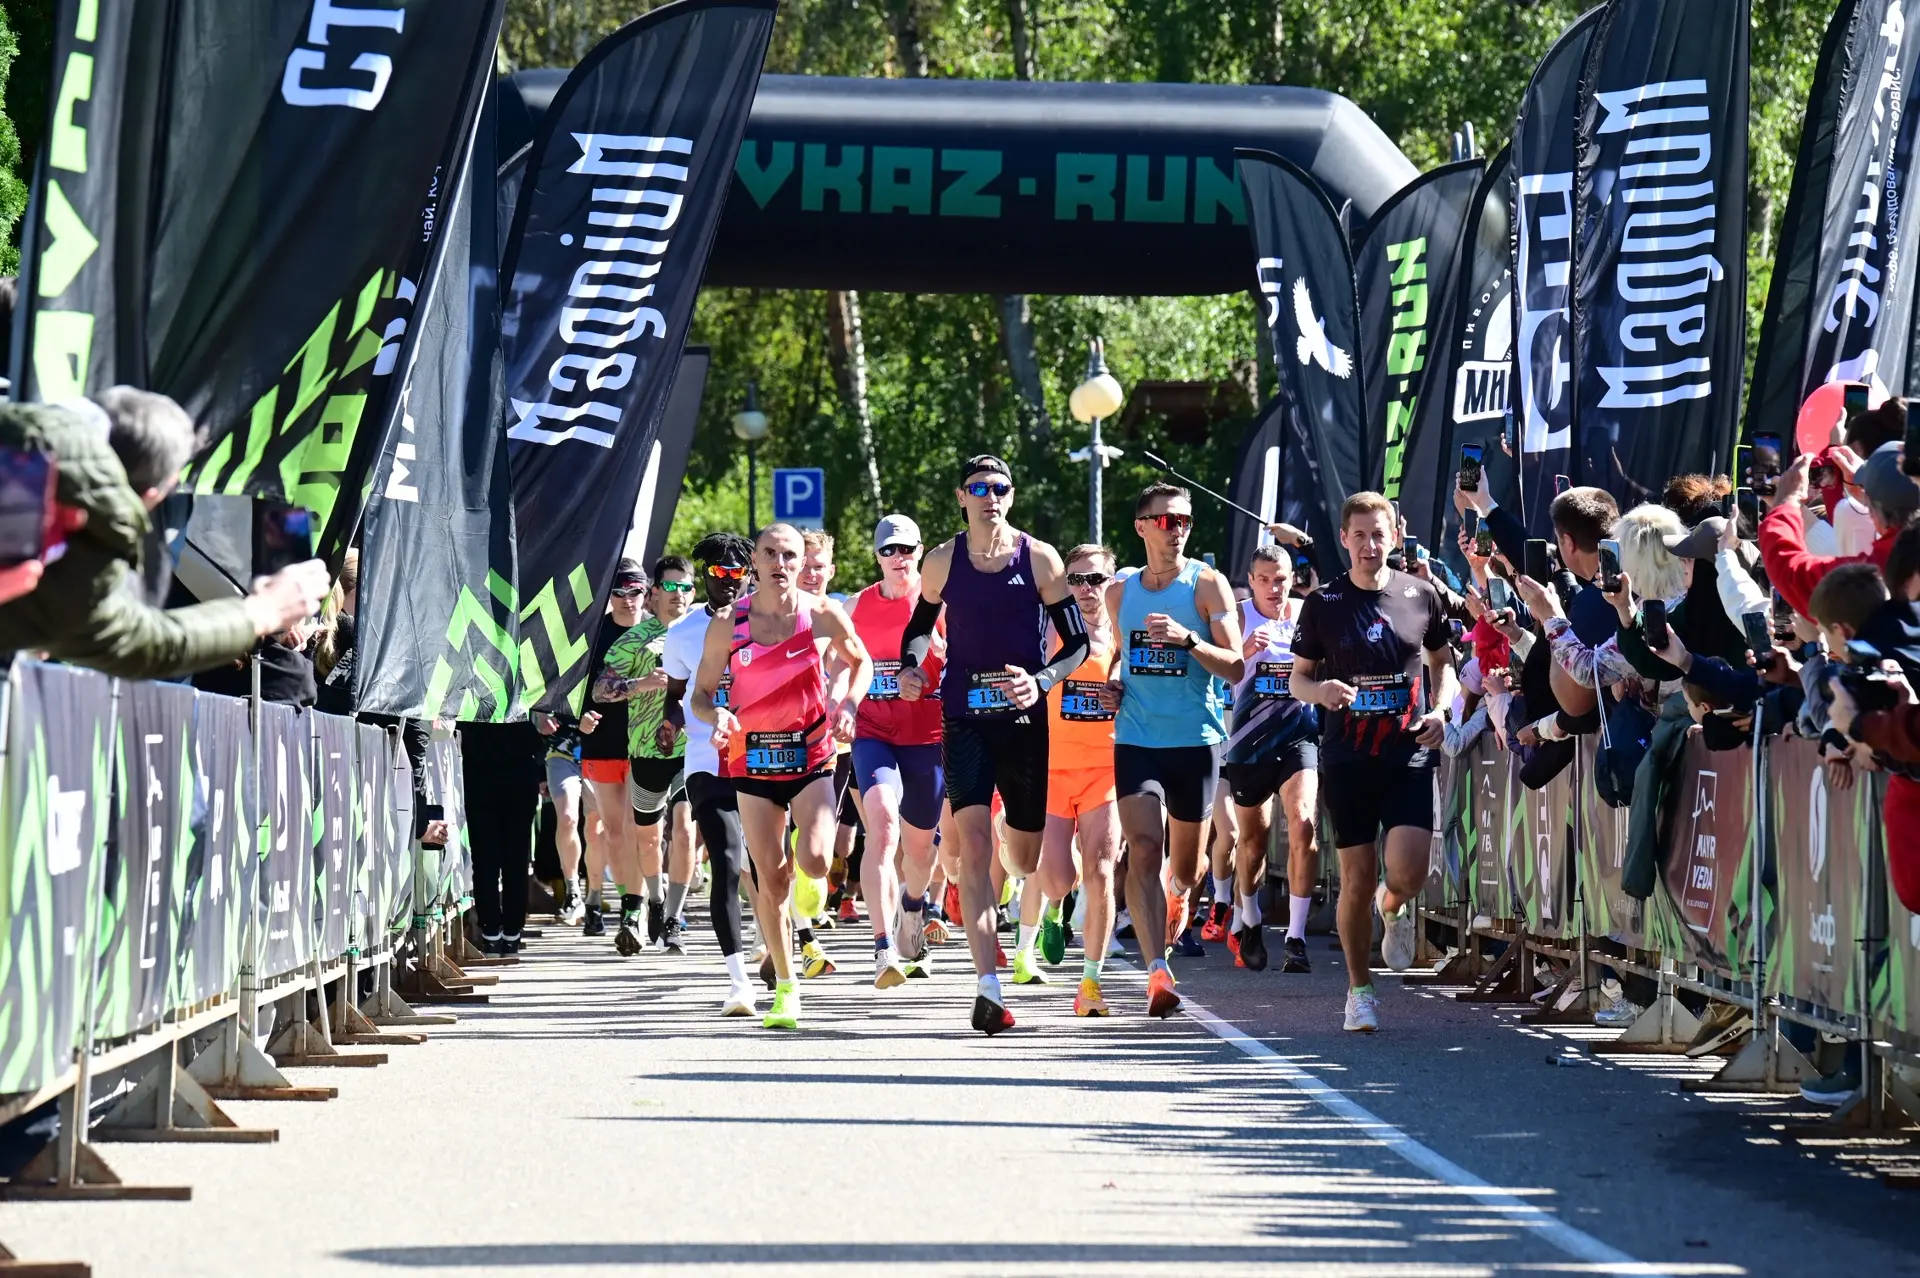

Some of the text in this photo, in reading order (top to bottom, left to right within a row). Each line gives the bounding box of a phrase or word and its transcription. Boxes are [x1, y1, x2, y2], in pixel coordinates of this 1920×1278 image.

[422, 202, 437, 243] чай.
[1462, 367, 1512, 417] МИ
[785, 474, 814, 515] P
[1139, 650, 1176, 664] 1268
[873, 677, 898, 690] 145
[1072, 697, 1105, 711] 149
[1360, 691, 1398, 706] 1214
[757, 750, 797, 764] 1108
[1695, 833, 1717, 859] MAYR
[1691, 864, 1713, 891] VEDA
